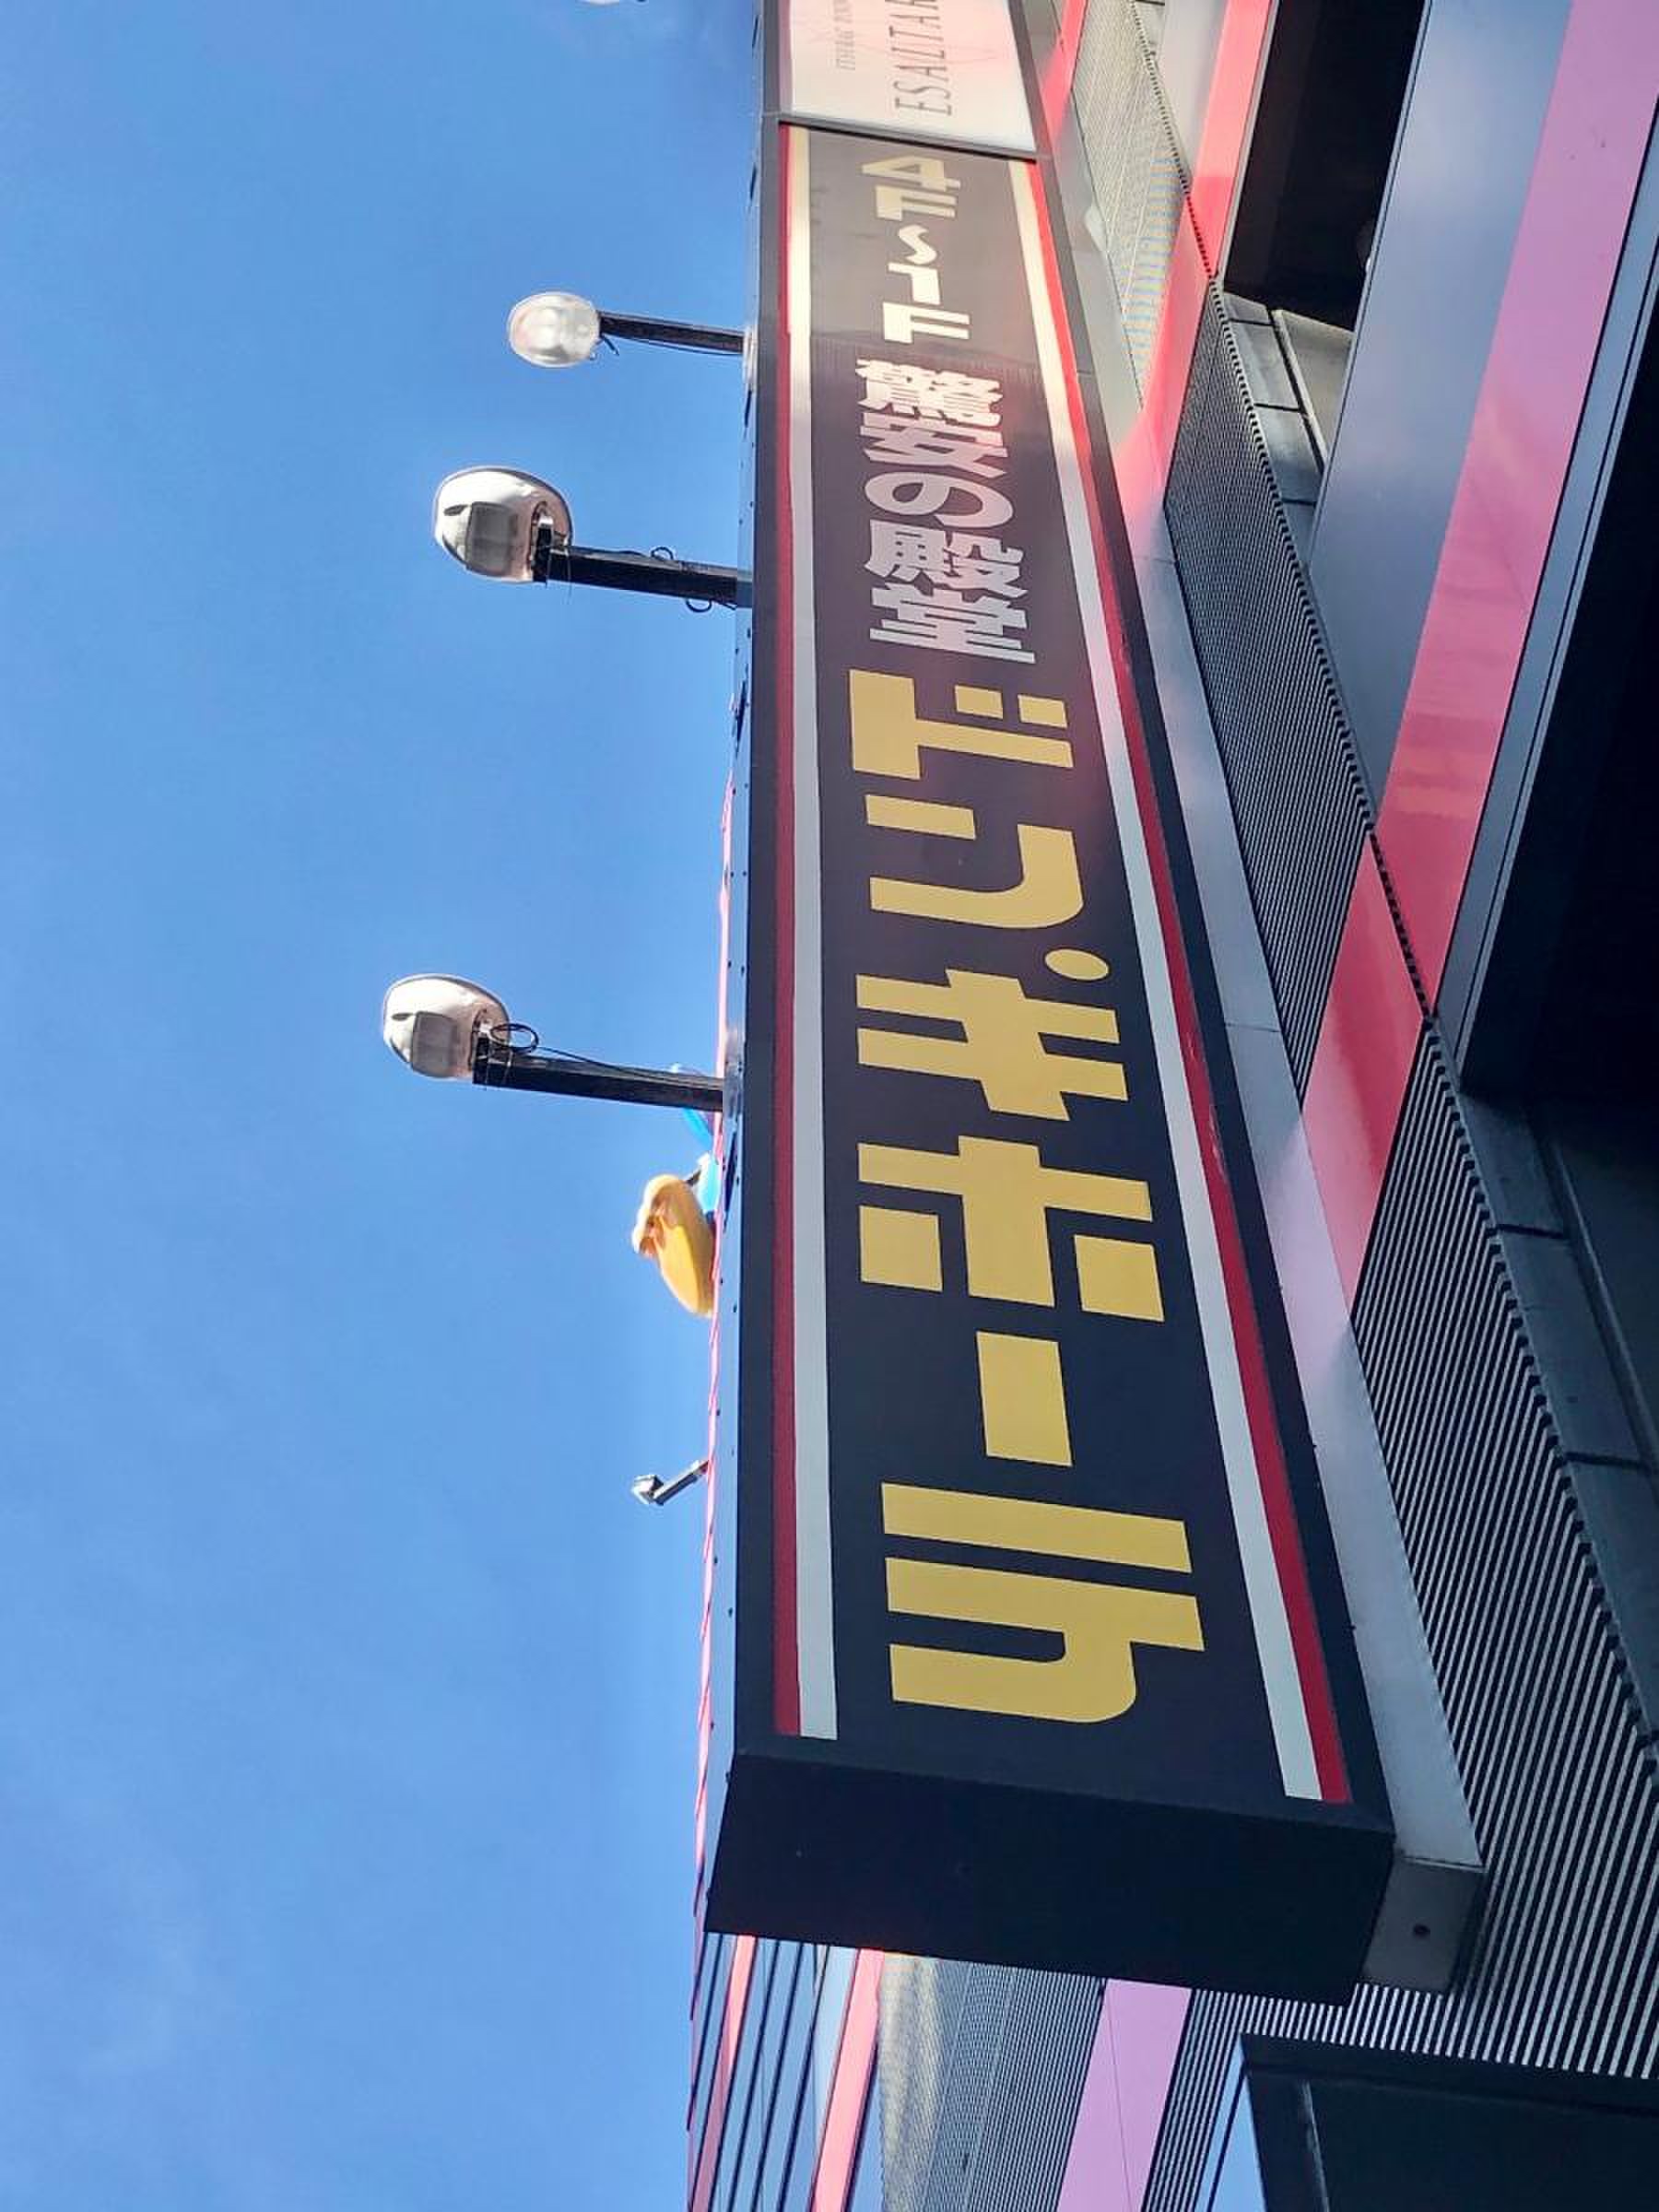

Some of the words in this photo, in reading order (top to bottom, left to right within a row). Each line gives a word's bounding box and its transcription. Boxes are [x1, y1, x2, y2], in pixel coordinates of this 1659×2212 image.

[855, 359, 1036, 665] 驚安の殿堂
[849, 669, 1206, 1724] ドン・キホーテ
